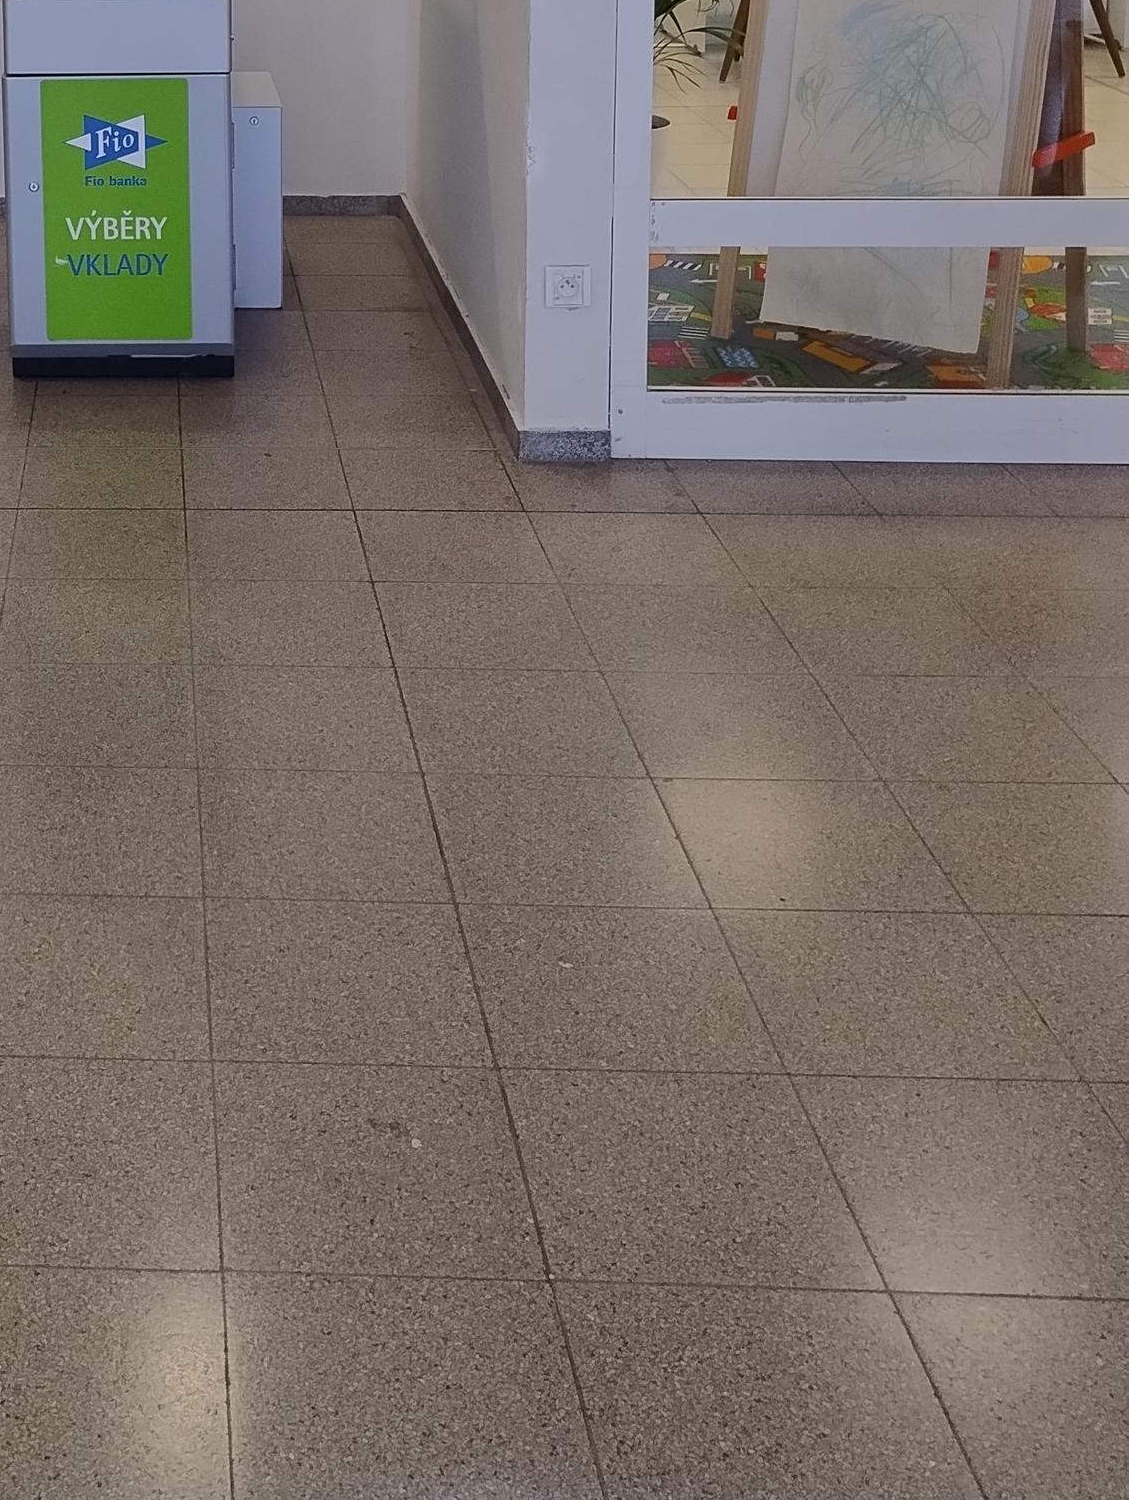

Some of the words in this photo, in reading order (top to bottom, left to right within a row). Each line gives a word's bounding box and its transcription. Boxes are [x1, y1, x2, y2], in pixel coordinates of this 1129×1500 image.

[94, 126, 134, 159] Fio
[84, 175, 105, 187] Fio
[109, 175, 147, 187] banka
[65, 210, 168, 240] VÝBĚRY
[67, 253, 169, 277] VKLADY
